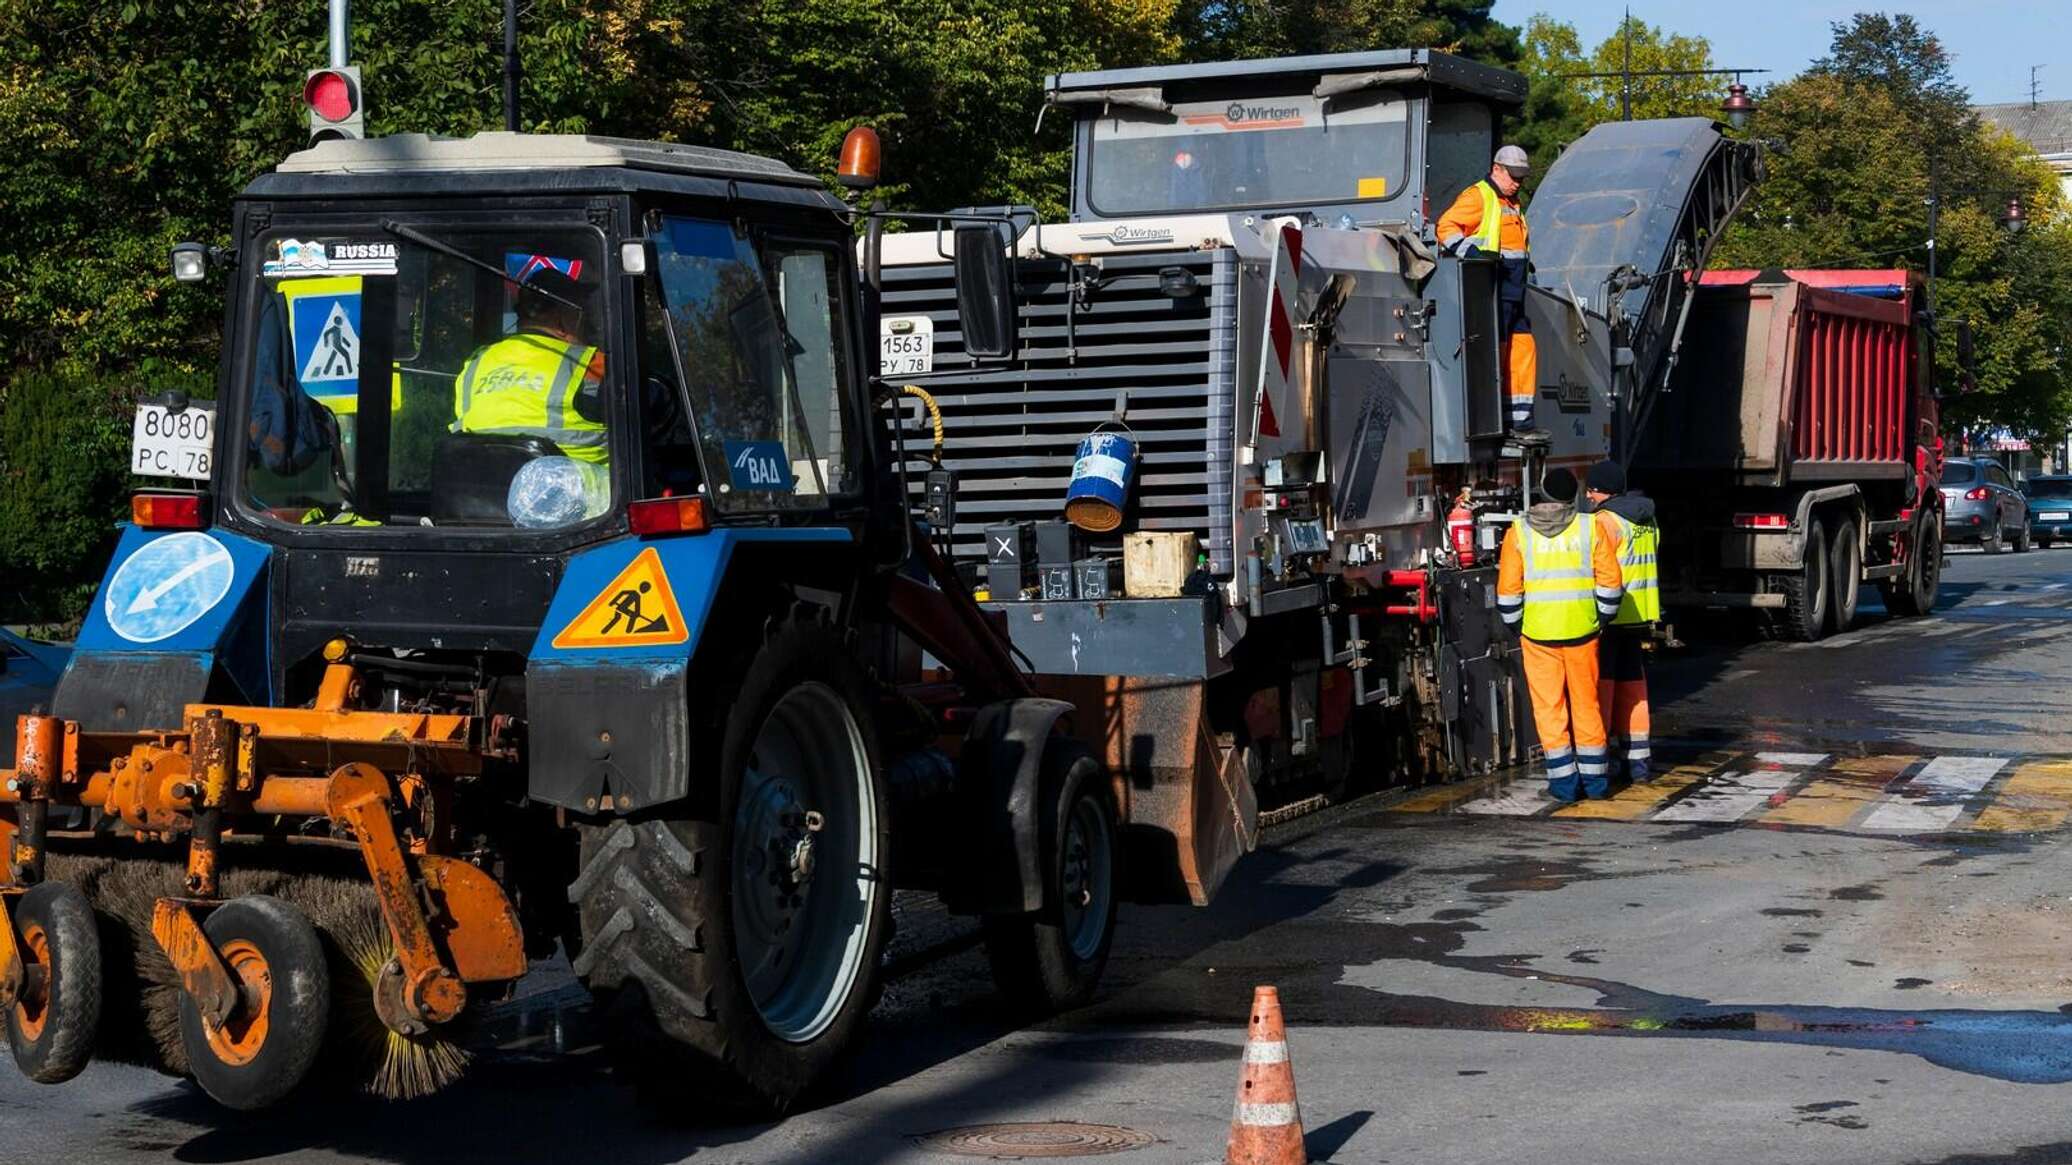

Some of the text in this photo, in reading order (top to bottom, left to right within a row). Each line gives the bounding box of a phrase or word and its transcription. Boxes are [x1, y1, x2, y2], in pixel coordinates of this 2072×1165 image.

[1247, 106, 1299, 120] Wirtgen
[1130, 228, 1170, 239] Wirtgen
[335, 243, 396, 259] RUSSIA
[883, 336, 922, 354] 1563
[909, 358, 924, 371] 78
[145, 410, 208, 440] 8080
[185, 452, 208, 474] 78
[747, 457, 781, 484] ВАД
